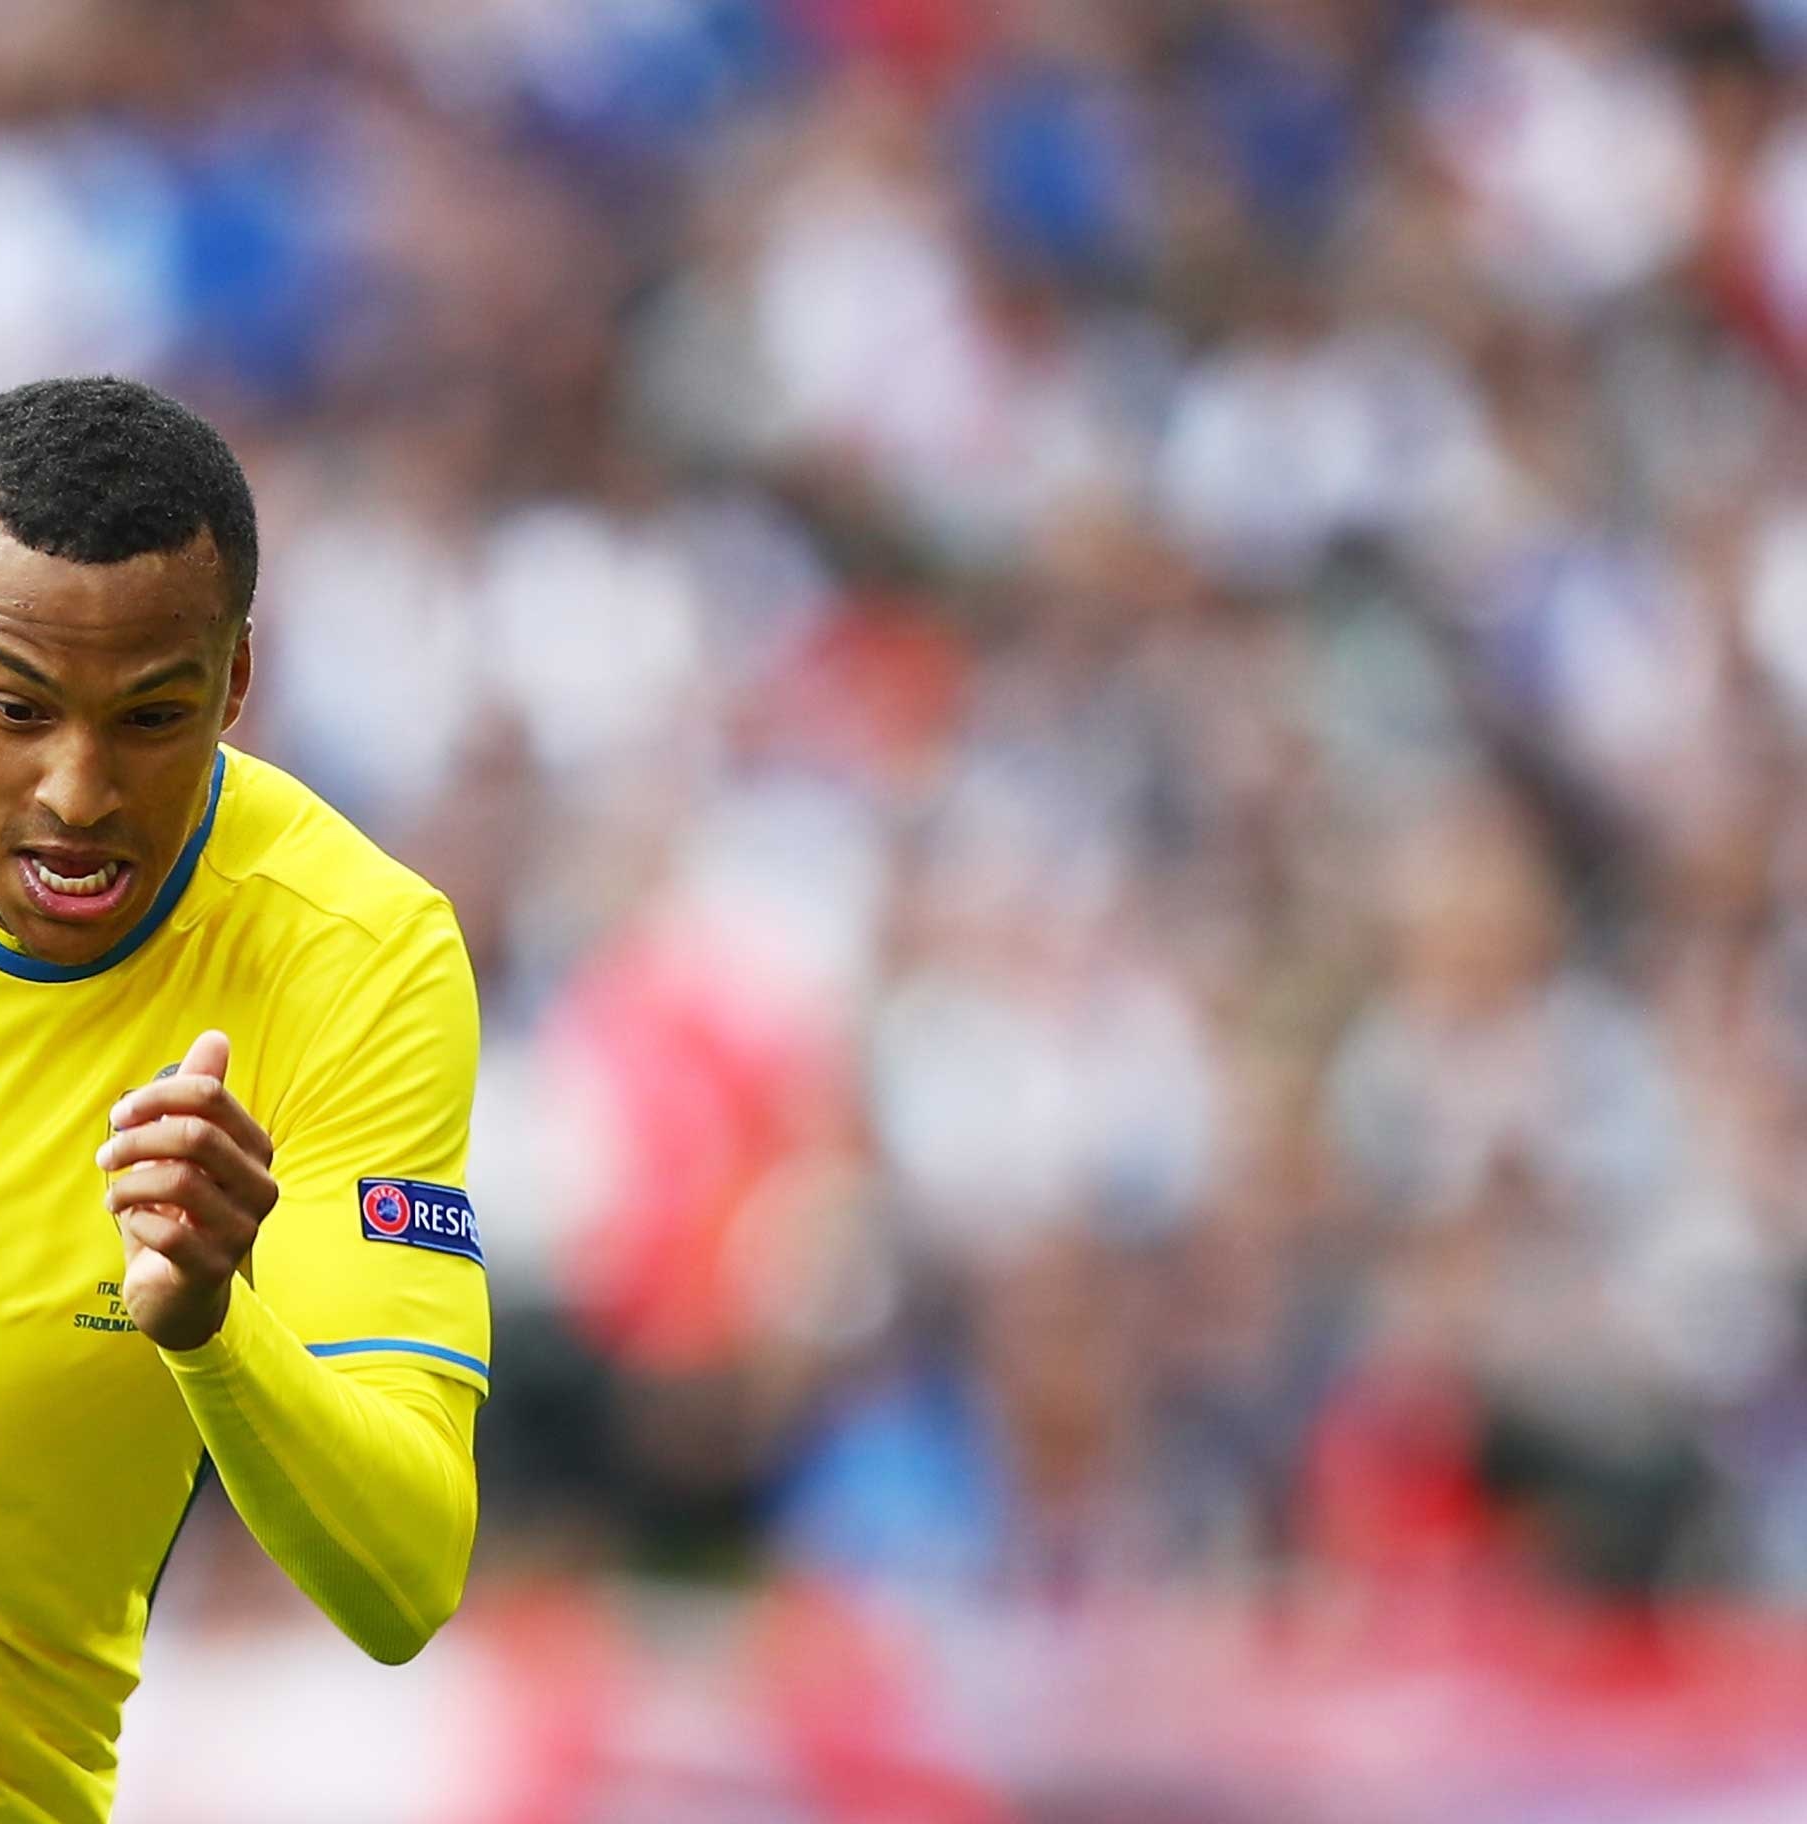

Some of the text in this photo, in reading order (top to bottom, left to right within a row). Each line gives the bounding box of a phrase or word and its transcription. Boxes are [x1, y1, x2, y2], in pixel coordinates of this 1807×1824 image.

[414, 1200, 480, 1247] RESP
[96, 1280, 122, 1297] ITAL
[73, 1313, 126, 1332] STADIUM
